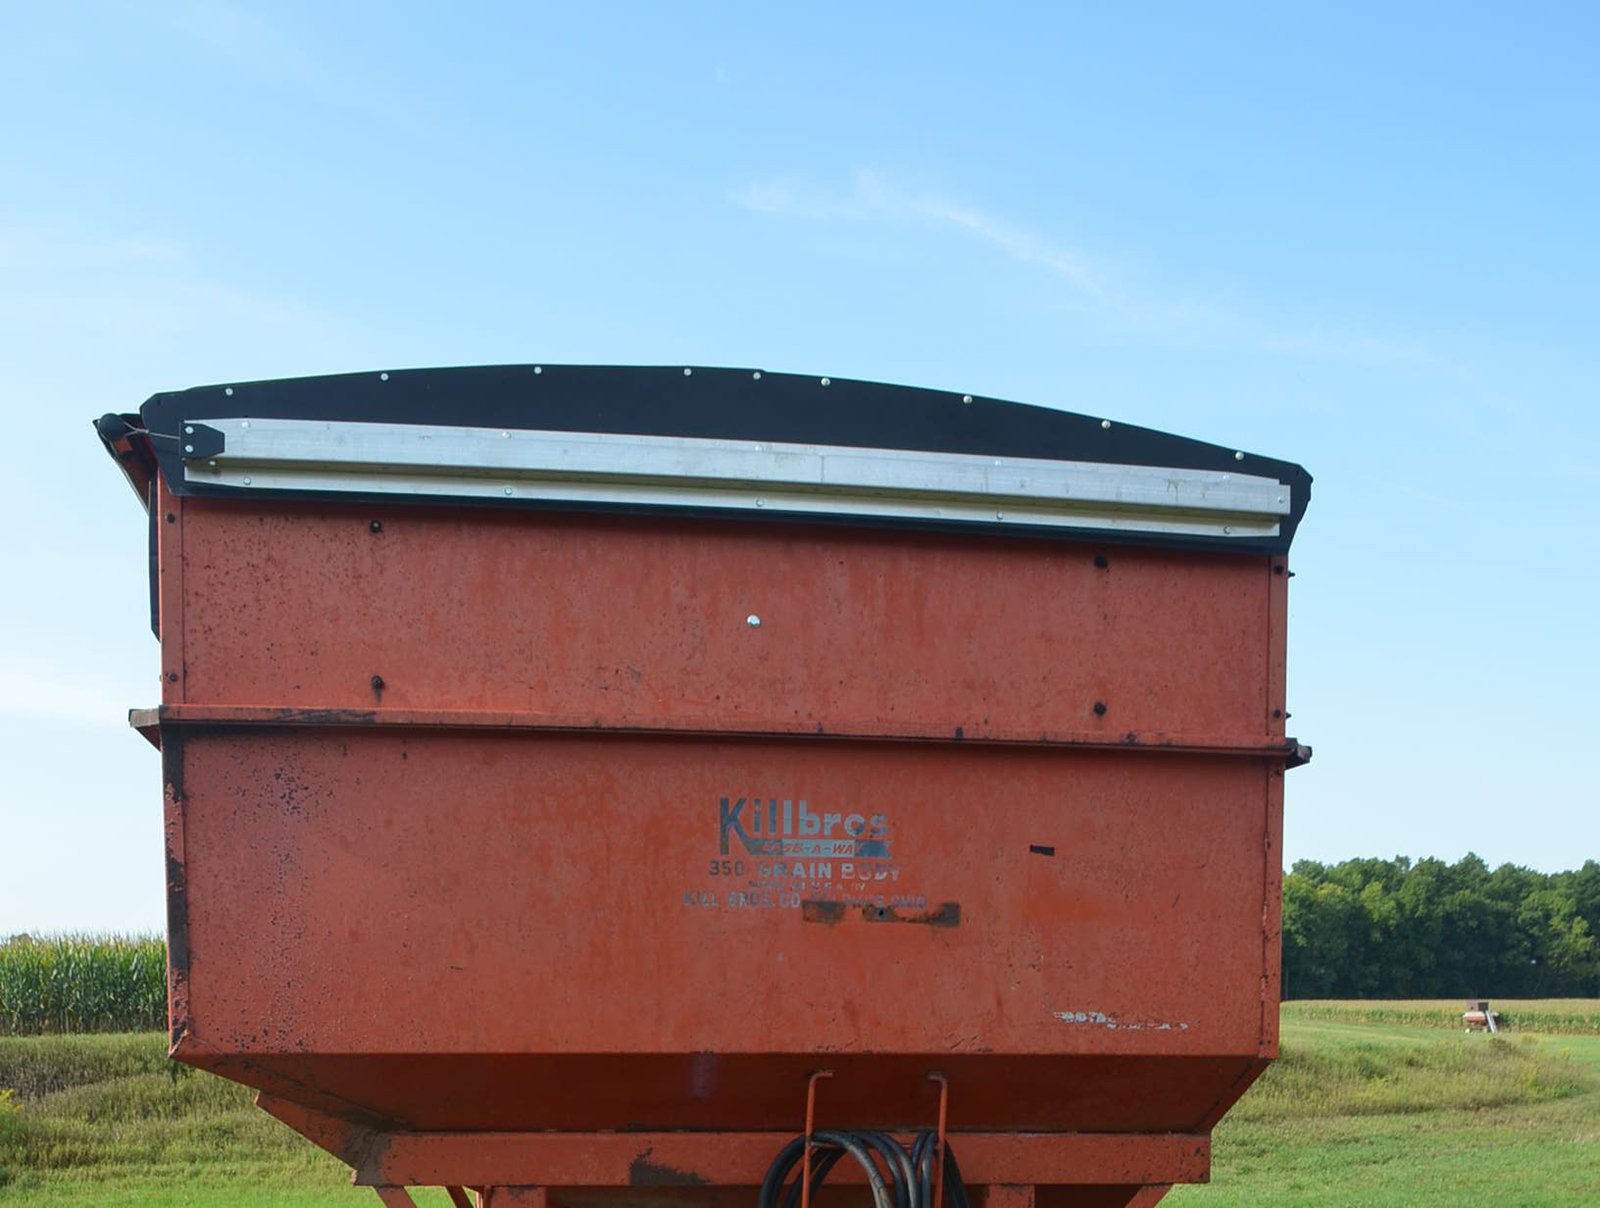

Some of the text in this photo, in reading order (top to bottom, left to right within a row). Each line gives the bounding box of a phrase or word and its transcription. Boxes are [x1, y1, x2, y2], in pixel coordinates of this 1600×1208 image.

[719, 798, 889, 855] Killbros
[709, 861, 901, 881] 350 GRAIN BODY
